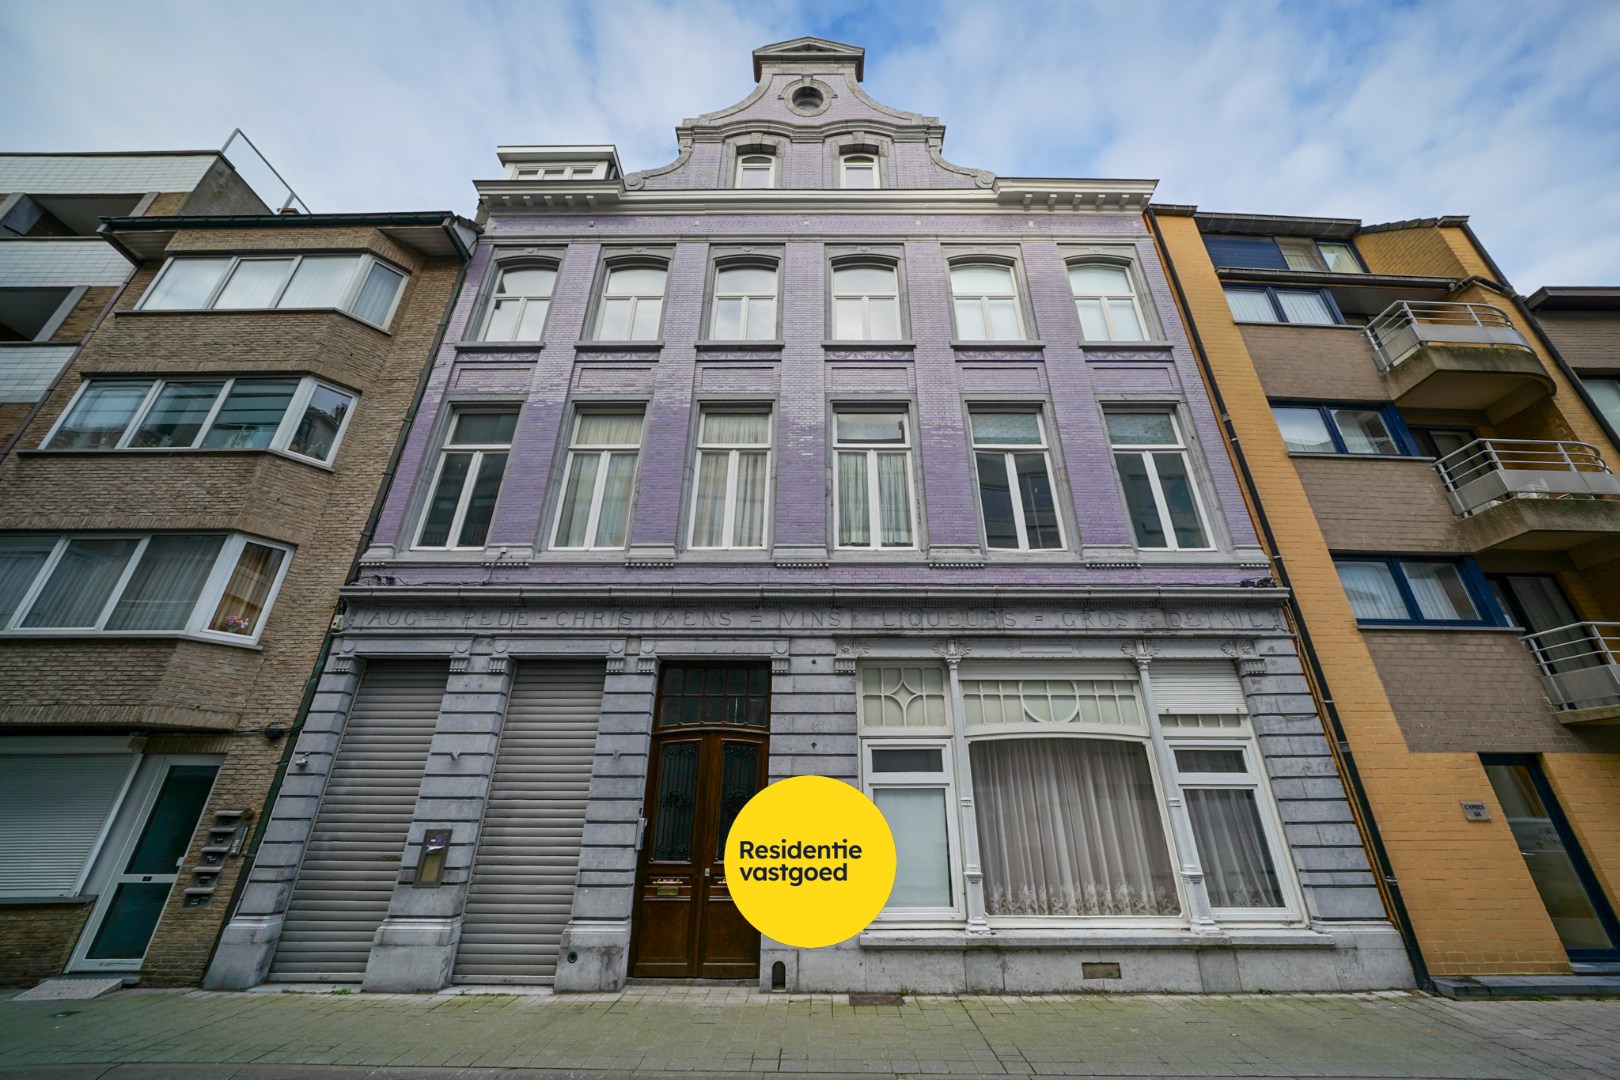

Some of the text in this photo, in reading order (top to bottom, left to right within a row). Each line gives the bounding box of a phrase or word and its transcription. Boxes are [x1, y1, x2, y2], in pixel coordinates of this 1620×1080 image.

[781, 611, 842, 627] VINS
[882, 611, 1017, 627] LIQUEURS
[1062, 611, 1129, 627] GROS
[1168, 612, 1264, 627] DETAIL
